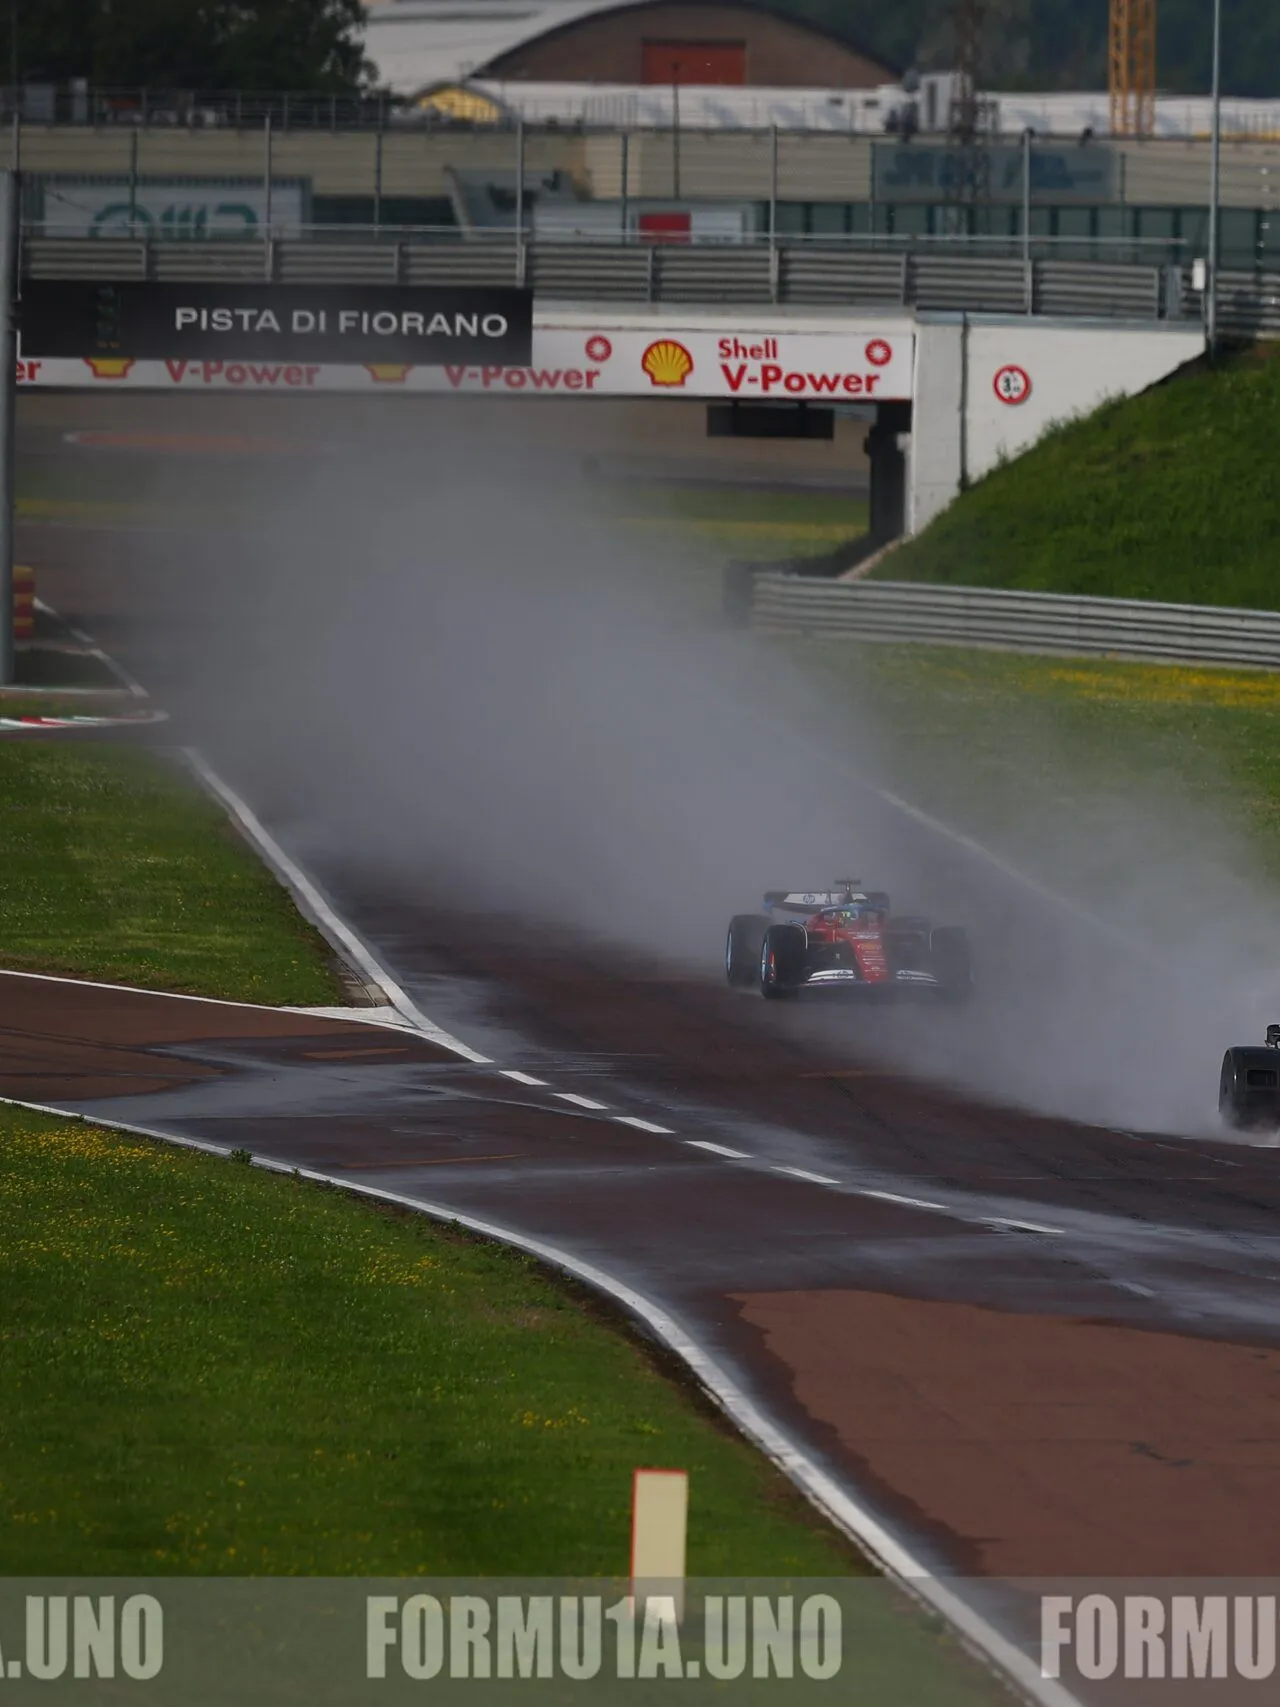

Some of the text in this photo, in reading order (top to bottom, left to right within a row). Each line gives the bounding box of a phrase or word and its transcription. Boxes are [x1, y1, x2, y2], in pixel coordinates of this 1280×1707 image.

[175, 307, 509, 338] PISTA DI FIORANO
[718, 337, 778, 360] Shell
[164, 357, 321, 386] V-Power
[443, 364, 601, 390] V-Power
[719, 363, 880, 394] V-Power
